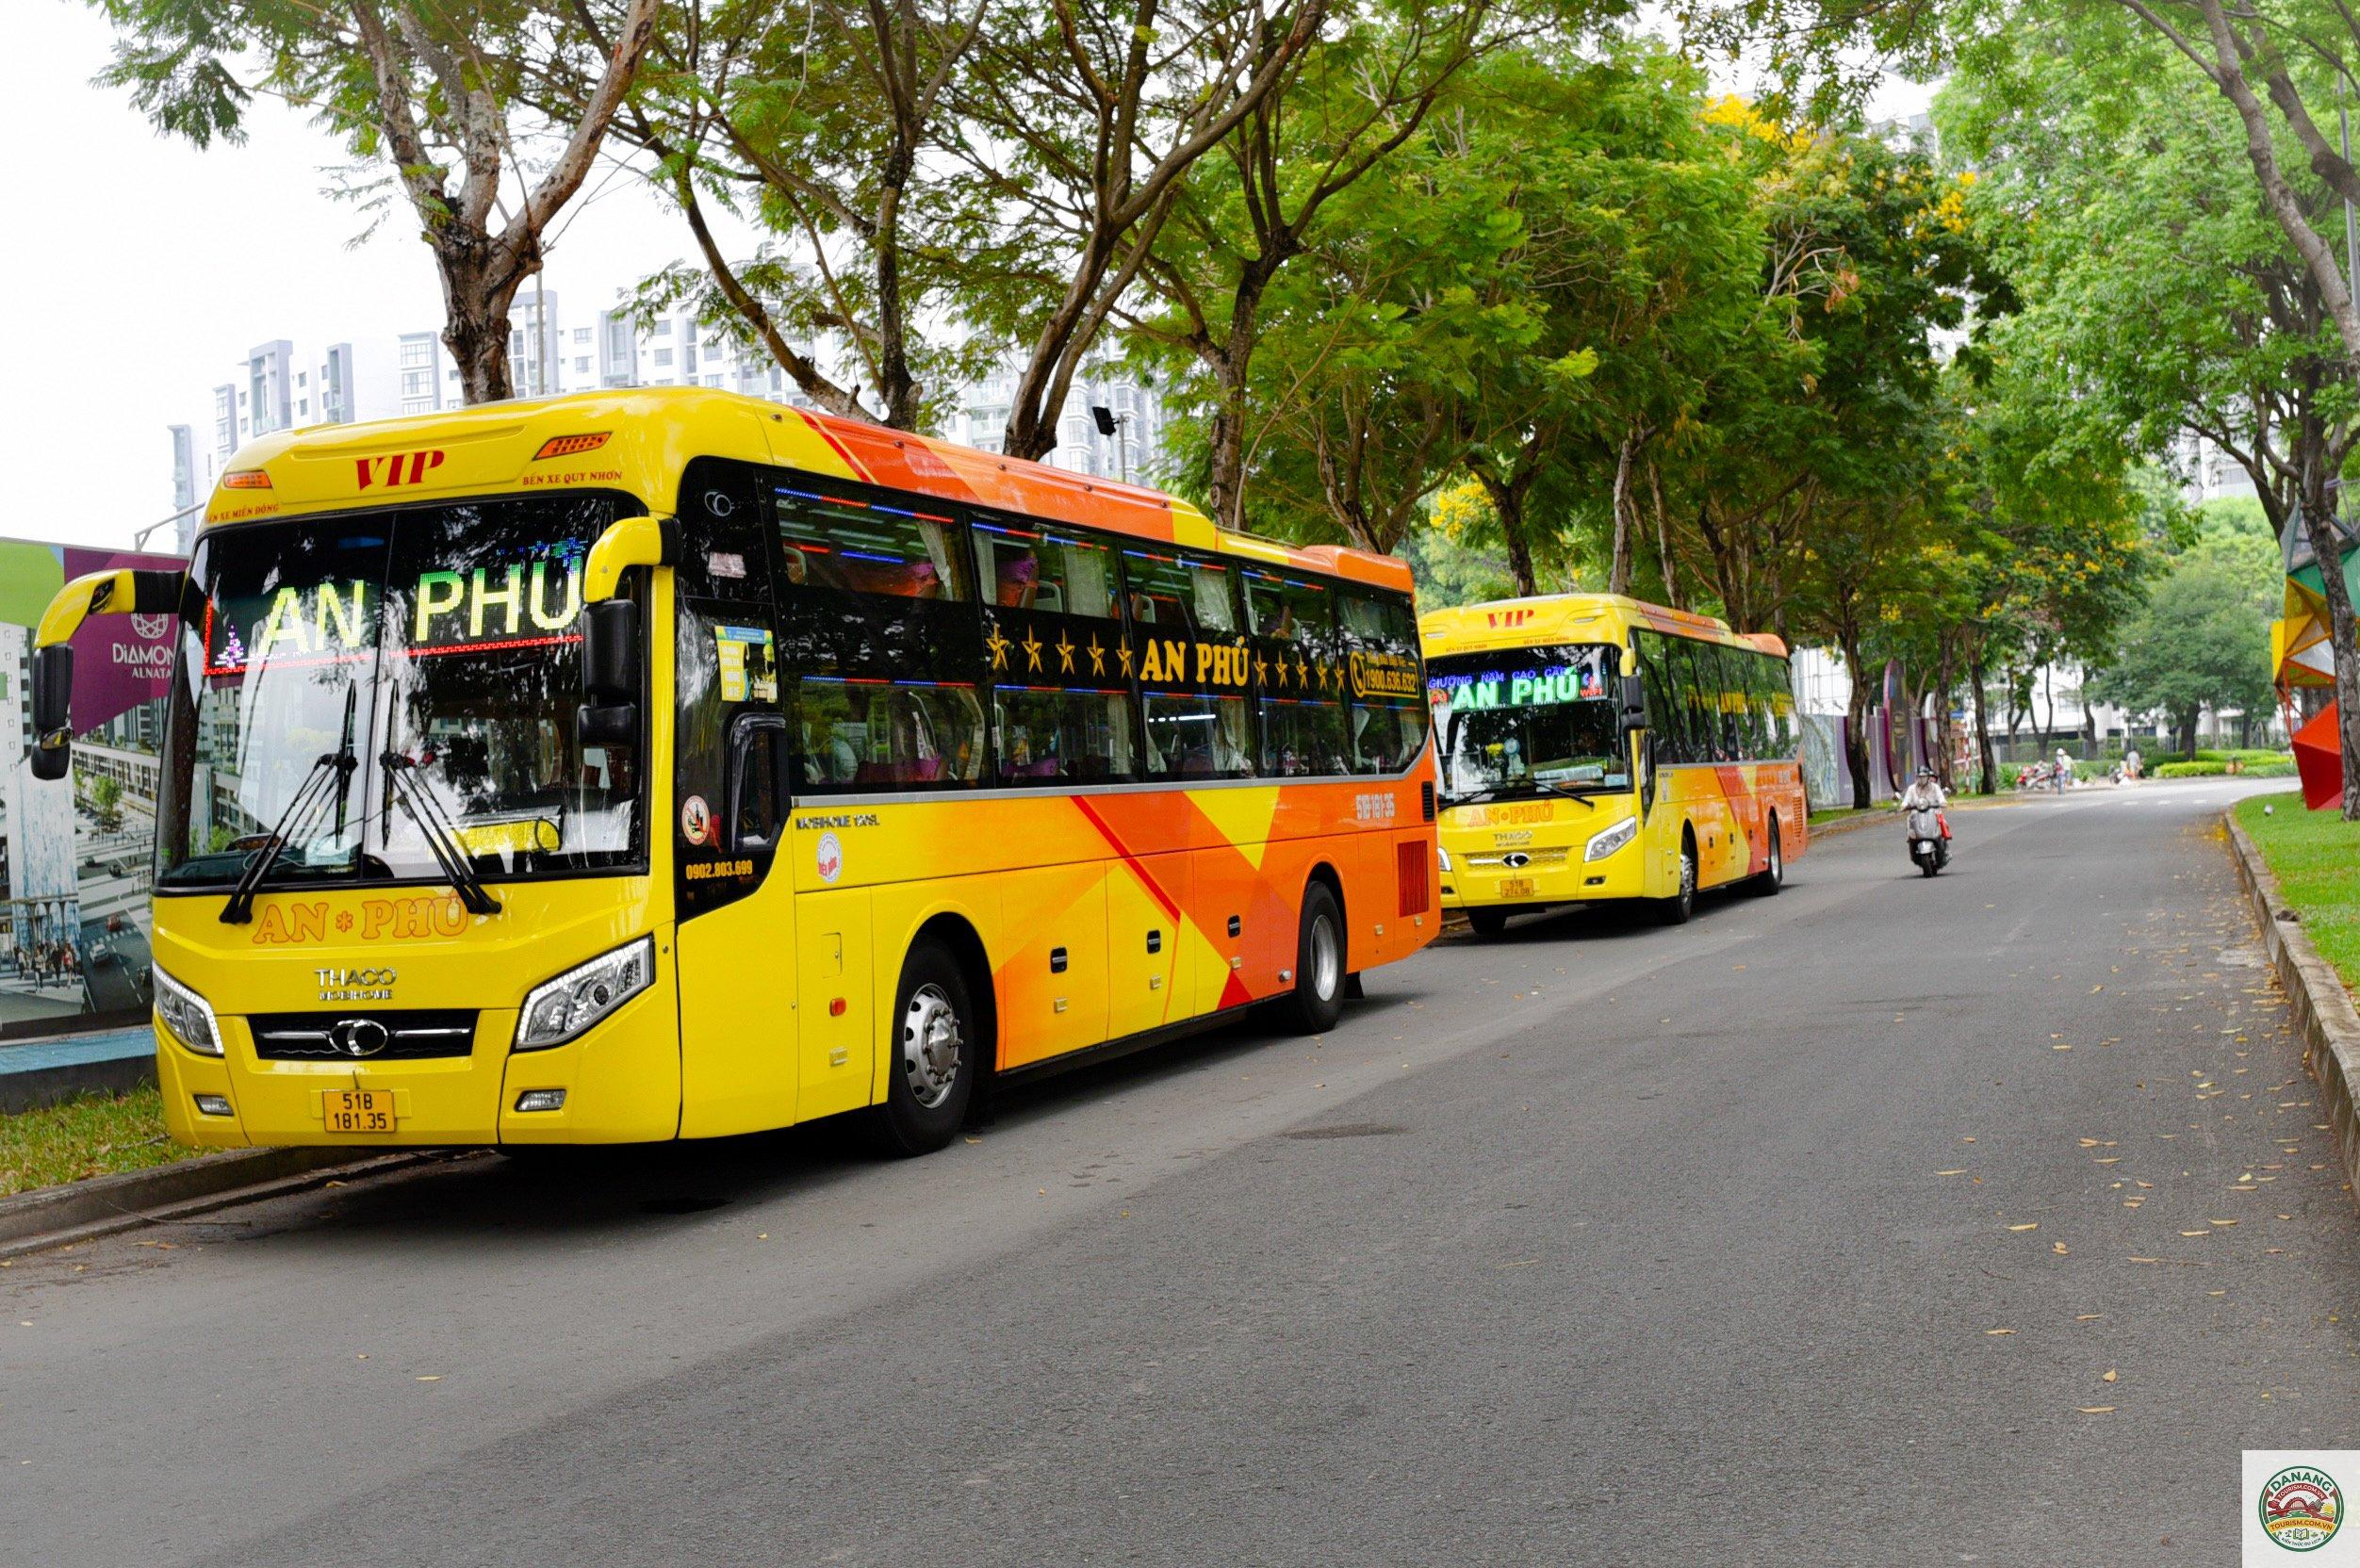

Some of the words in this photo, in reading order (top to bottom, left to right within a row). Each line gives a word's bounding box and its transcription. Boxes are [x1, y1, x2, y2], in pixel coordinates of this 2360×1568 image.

[355, 449, 445, 491] VIP
[547, 473, 562, 484] XE
[564, 472, 586, 485] QUY
[258, 579, 365, 655] AN
[1487, 609, 1534, 629] VIP
[1139, 638, 1187, 682] AN
[1195, 634, 1250, 687] PHÚ
[1365, 668, 1417, 693] 1900.636.632
[1511, 667, 1536, 679] CAO
[1451, 681, 1500, 710] AN
[1511, 665, 1580, 705] PHÚ
[1467, 807, 1500, 828] AN
[1509, 799, 1554, 825] PHÚ
[685, 858, 753, 880] 0902.803.699
[252, 901, 330, 945] AN
[314, 966, 398, 988] THACO
[319, 988, 394, 1001] MOBIHOME
[342, 1092, 373, 1110] 51B
[333, 1112, 387, 1130] 181.35
